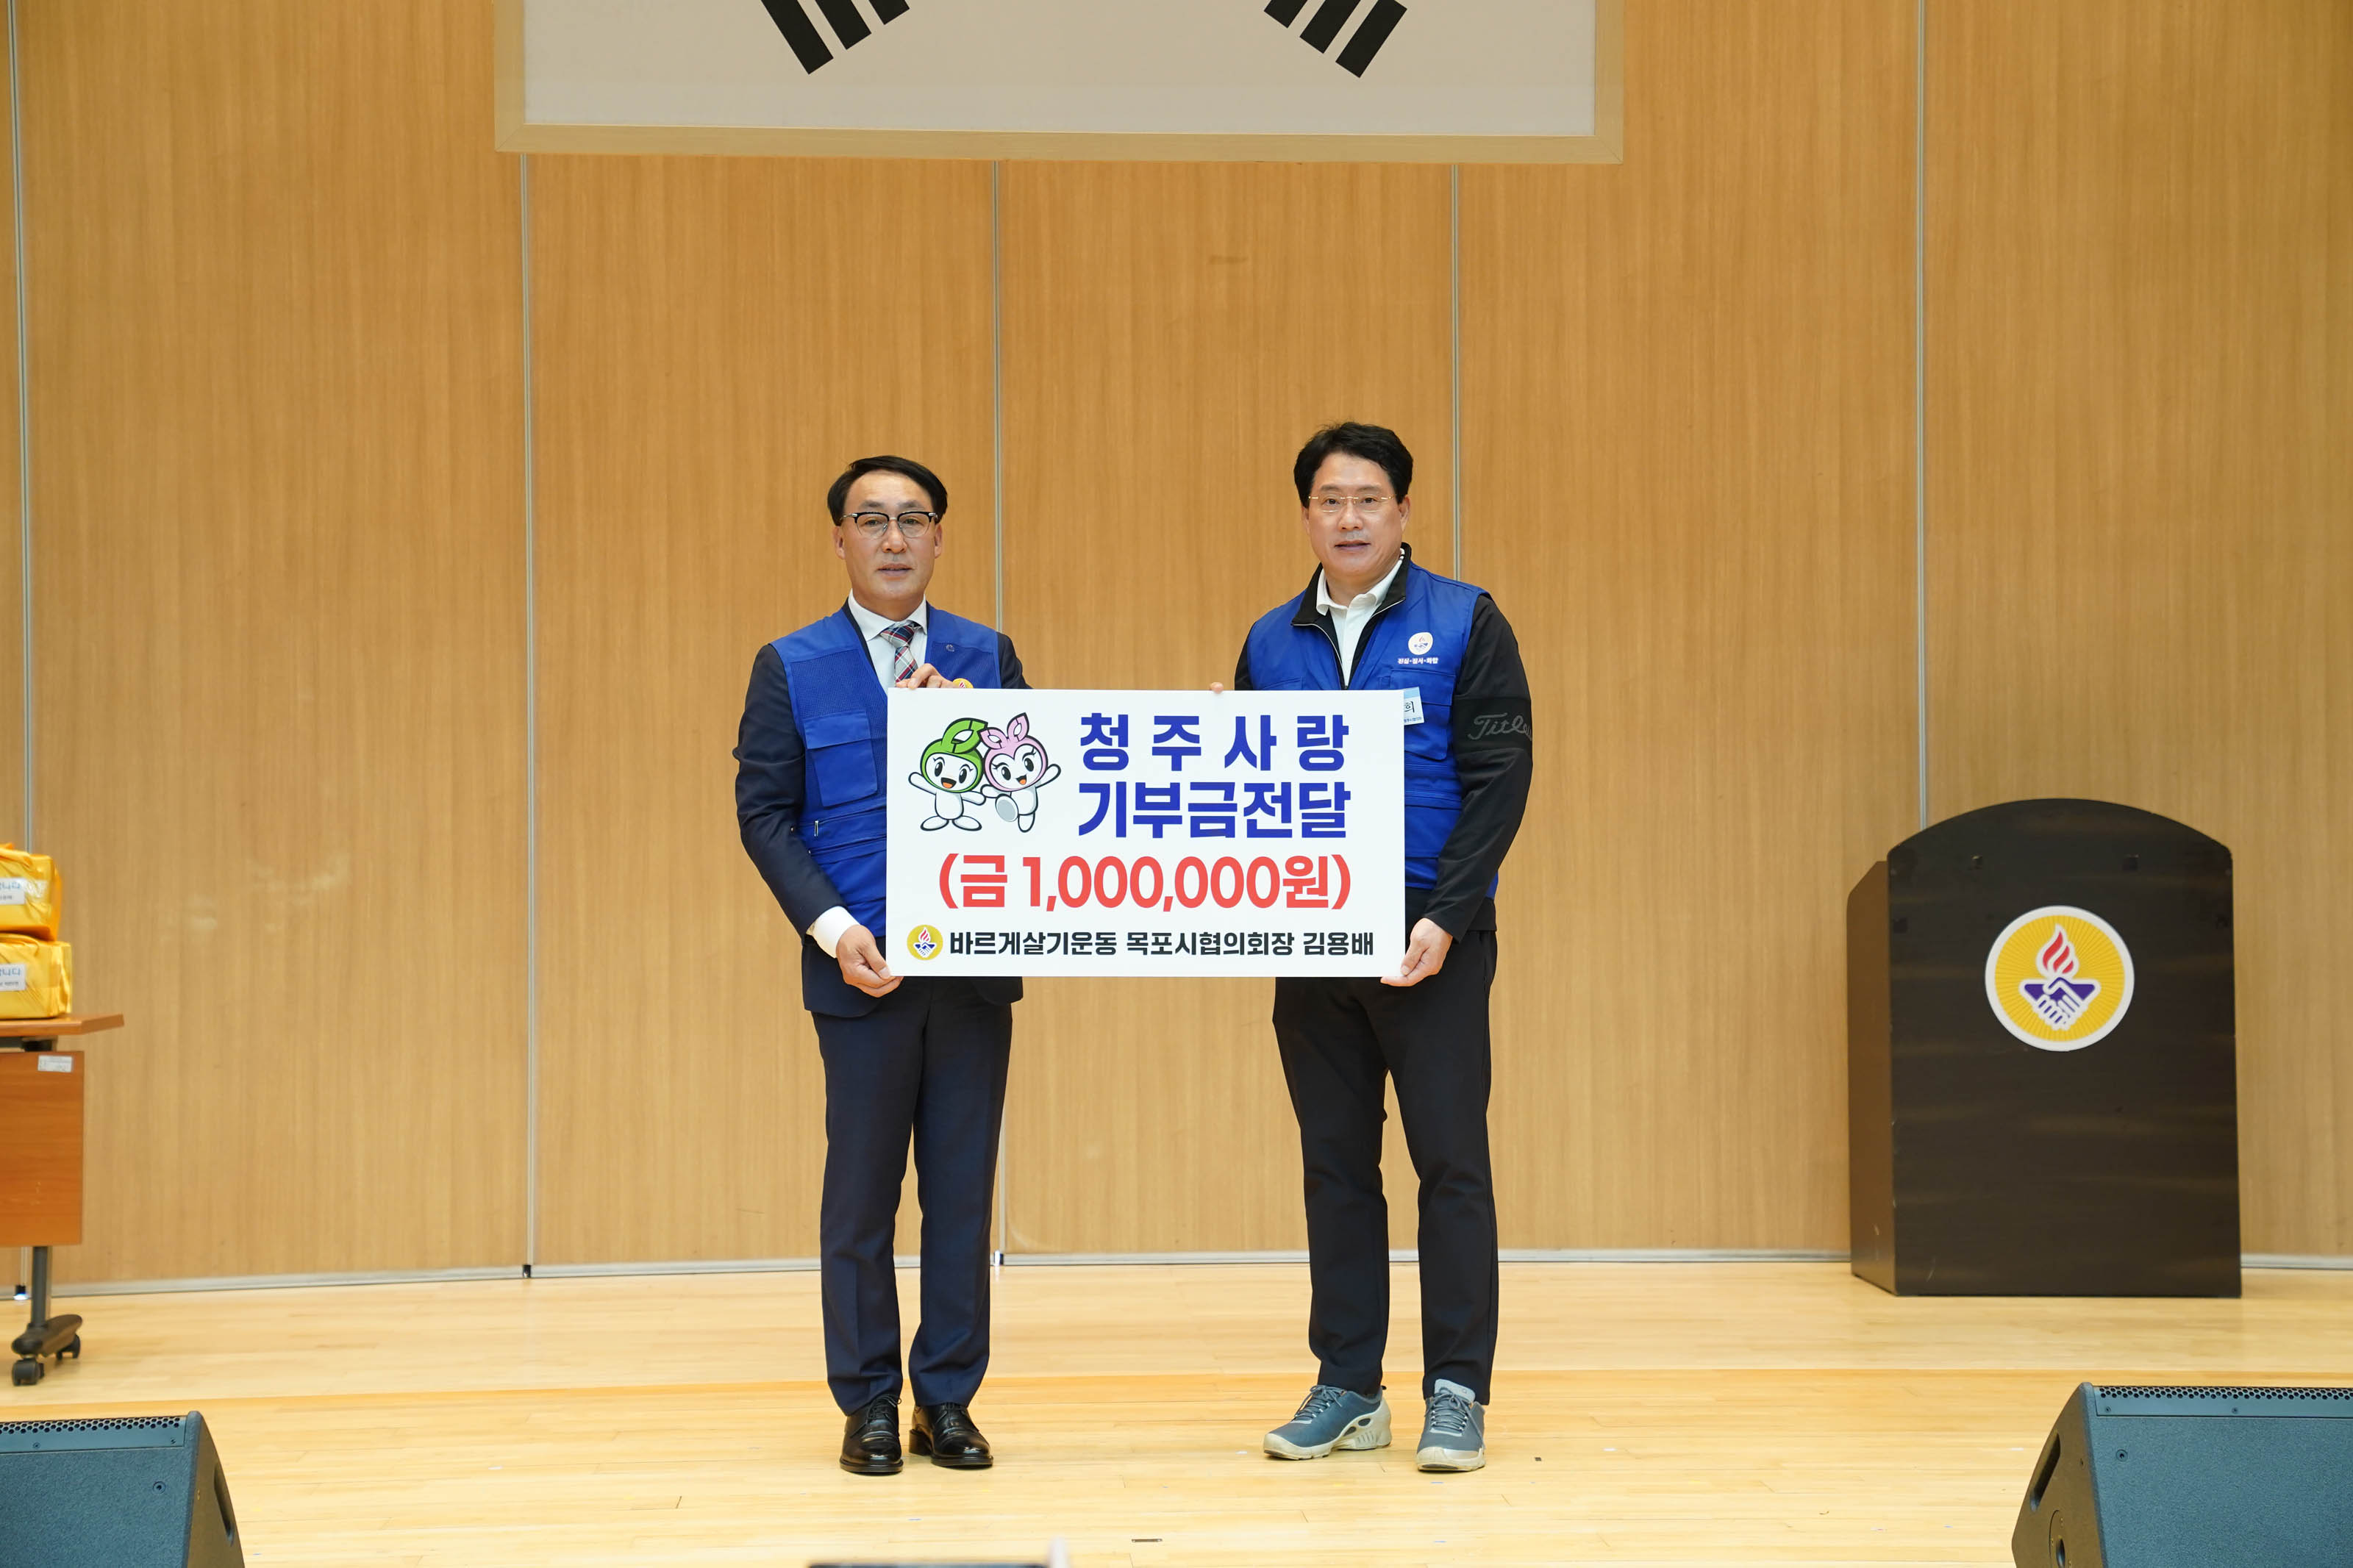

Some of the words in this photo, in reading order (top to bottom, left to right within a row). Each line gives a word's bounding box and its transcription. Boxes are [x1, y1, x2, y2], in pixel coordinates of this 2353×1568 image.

[1078, 781, 1352, 839] 기부금전달
[939, 853, 1008, 909] (금
[1023, 854, 1351, 912] 1,000,000원)
[950, 931, 1117, 956] 바르게살기운동
[1126, 931, 1295, 956] 목포시협의회장
[1303, 932, 1374, 956] 김용배
